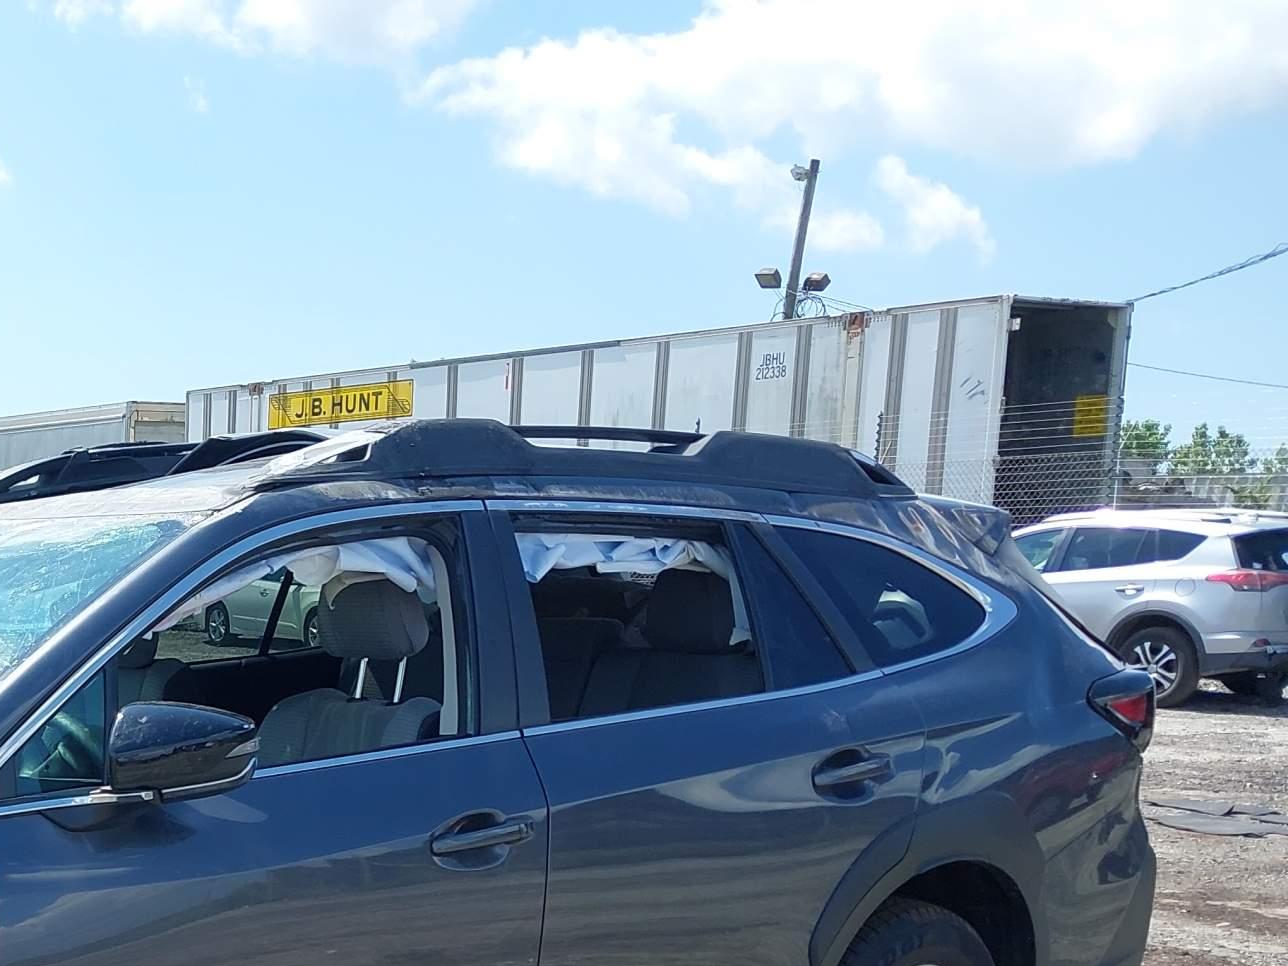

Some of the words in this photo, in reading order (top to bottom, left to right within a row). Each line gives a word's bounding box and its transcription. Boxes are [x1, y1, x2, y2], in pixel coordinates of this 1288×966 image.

[759, 351, 786, 367] JBHU
[755, 364, 787, 380] 212338
[331, 391, 383, 415] HUNT
